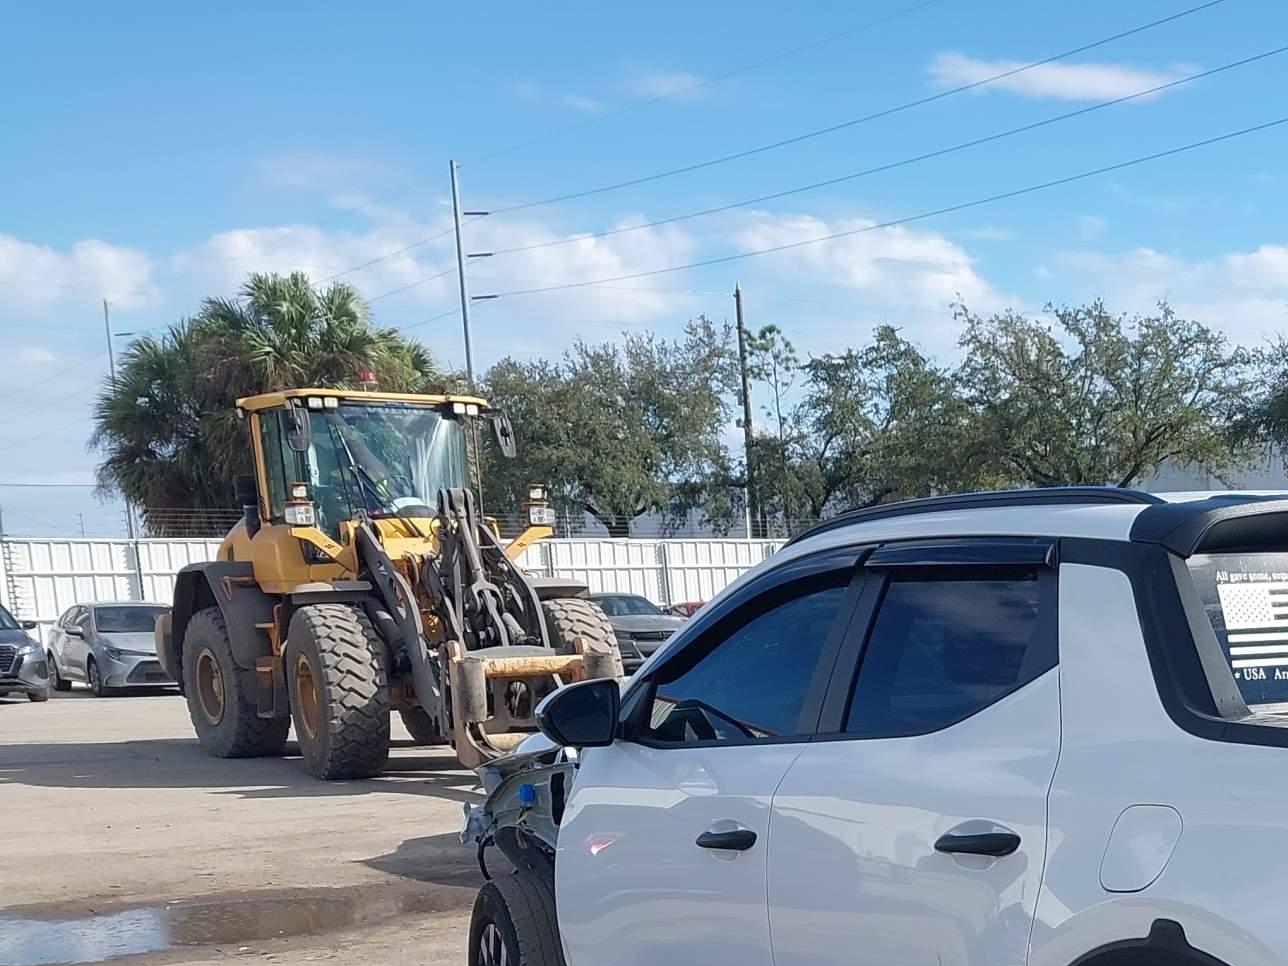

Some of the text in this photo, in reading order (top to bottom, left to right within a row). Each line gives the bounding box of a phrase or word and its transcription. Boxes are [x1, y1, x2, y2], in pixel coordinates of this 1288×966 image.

[1216, 570, 1228, 582] All
[1230, 573, 1247, 583] gave
[1243, 667, 1266, 681] USA
